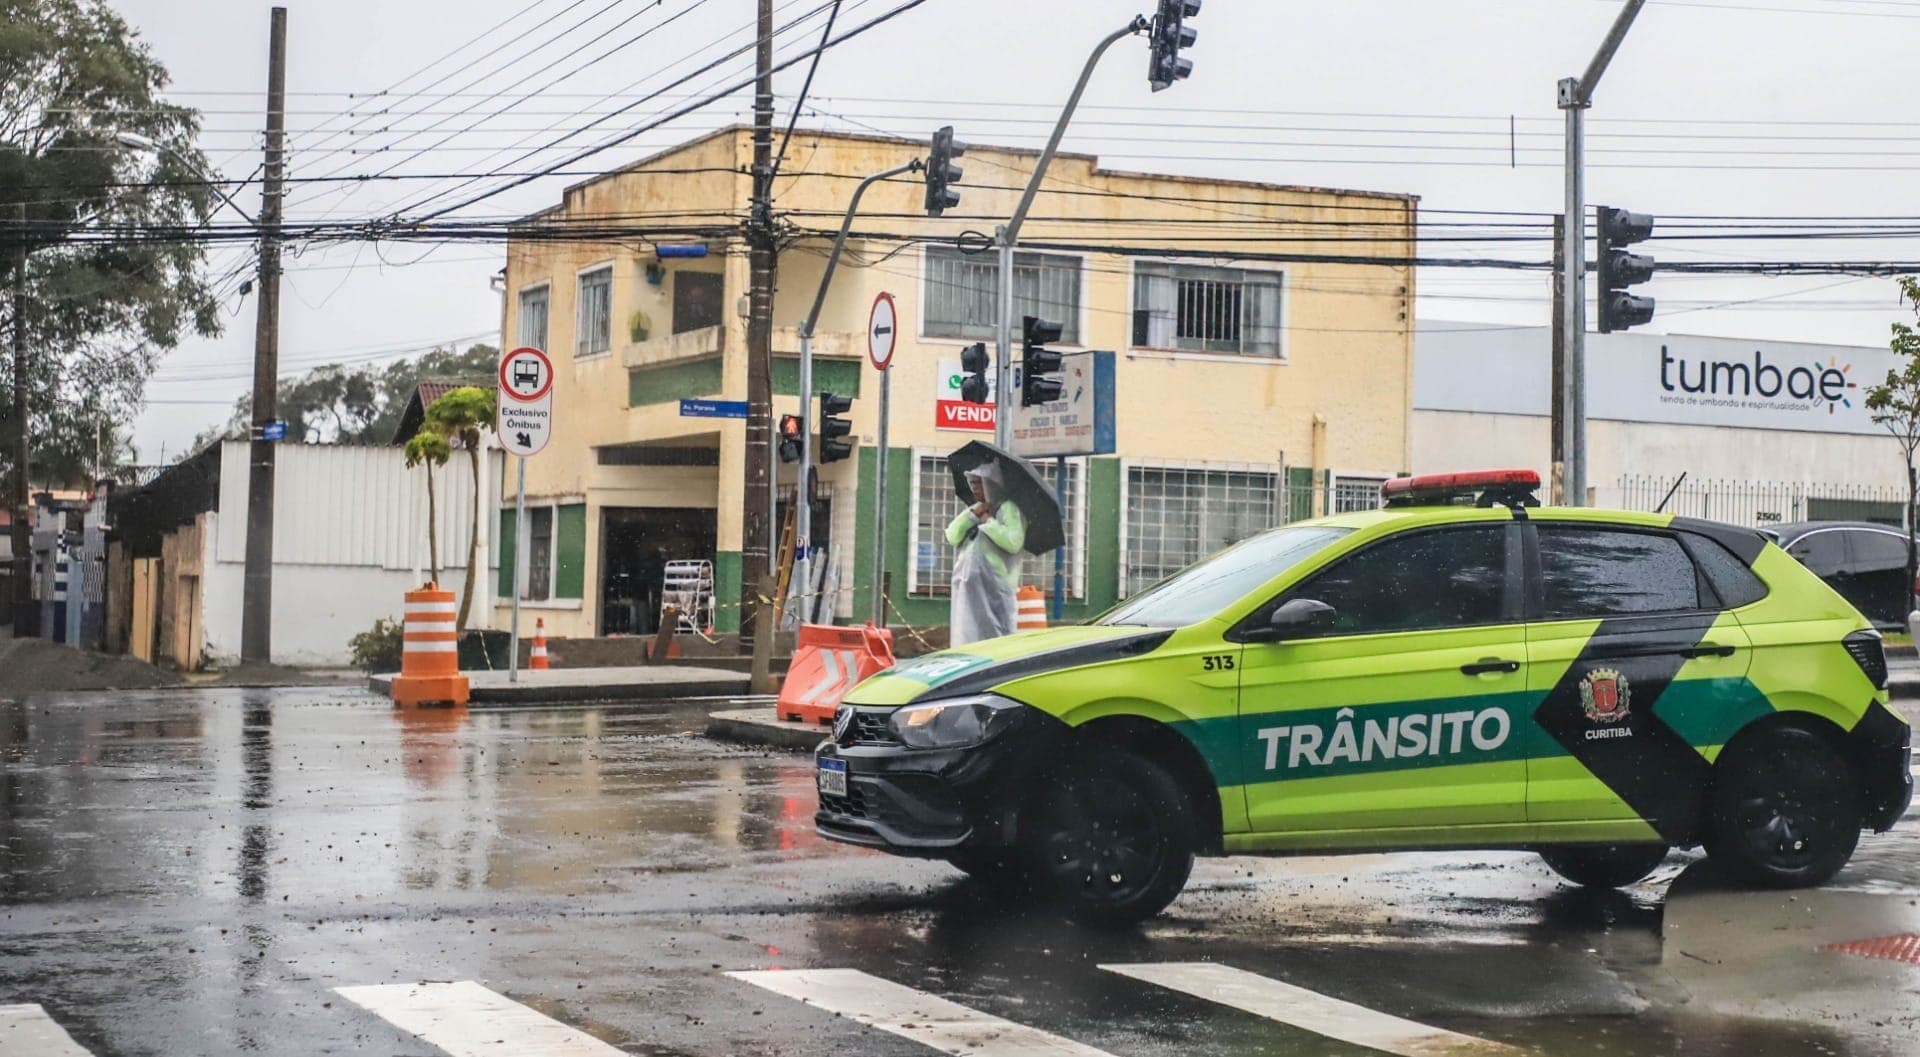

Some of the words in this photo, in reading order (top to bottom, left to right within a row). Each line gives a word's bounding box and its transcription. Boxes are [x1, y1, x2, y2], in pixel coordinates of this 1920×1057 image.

[1686, 396, 1697, 405] de
[1748, 401, 1810, 411] espiritualidade
[502, 407, 548, 418] Exclusivo
[506, 418, 542, 430] Ônibus
[1756, 511, 1783, 522] 2500
[1202, 655, 1235, 671] 313
[1257, 706, 1511, 771] TRÂNSITO
[1585, 727, 1633, 740] CURITIBA
